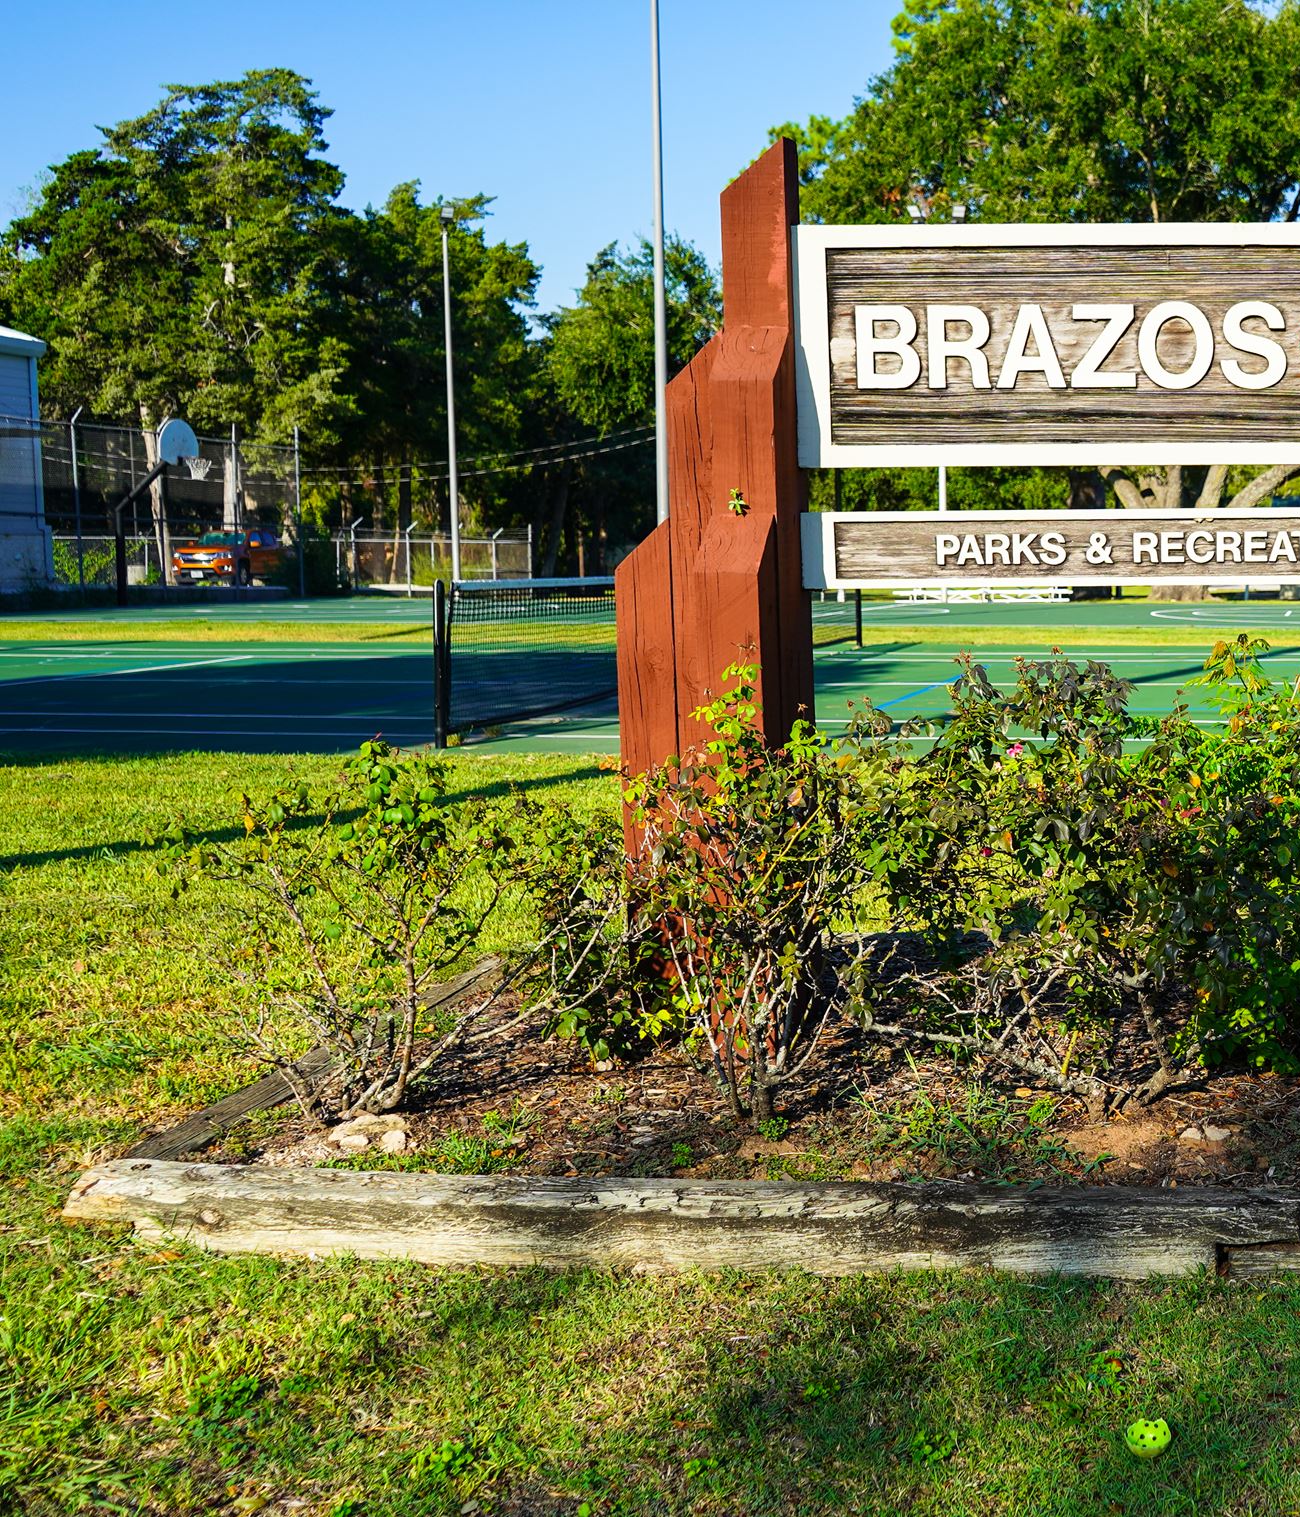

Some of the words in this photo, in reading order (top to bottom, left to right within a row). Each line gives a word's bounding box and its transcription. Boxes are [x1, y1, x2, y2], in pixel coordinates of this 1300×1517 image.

[855, 301, 1288, 389] BRAZOS
[935, 532, 1067, 566] PARKS
[1085, 532, 1114, 565] &
